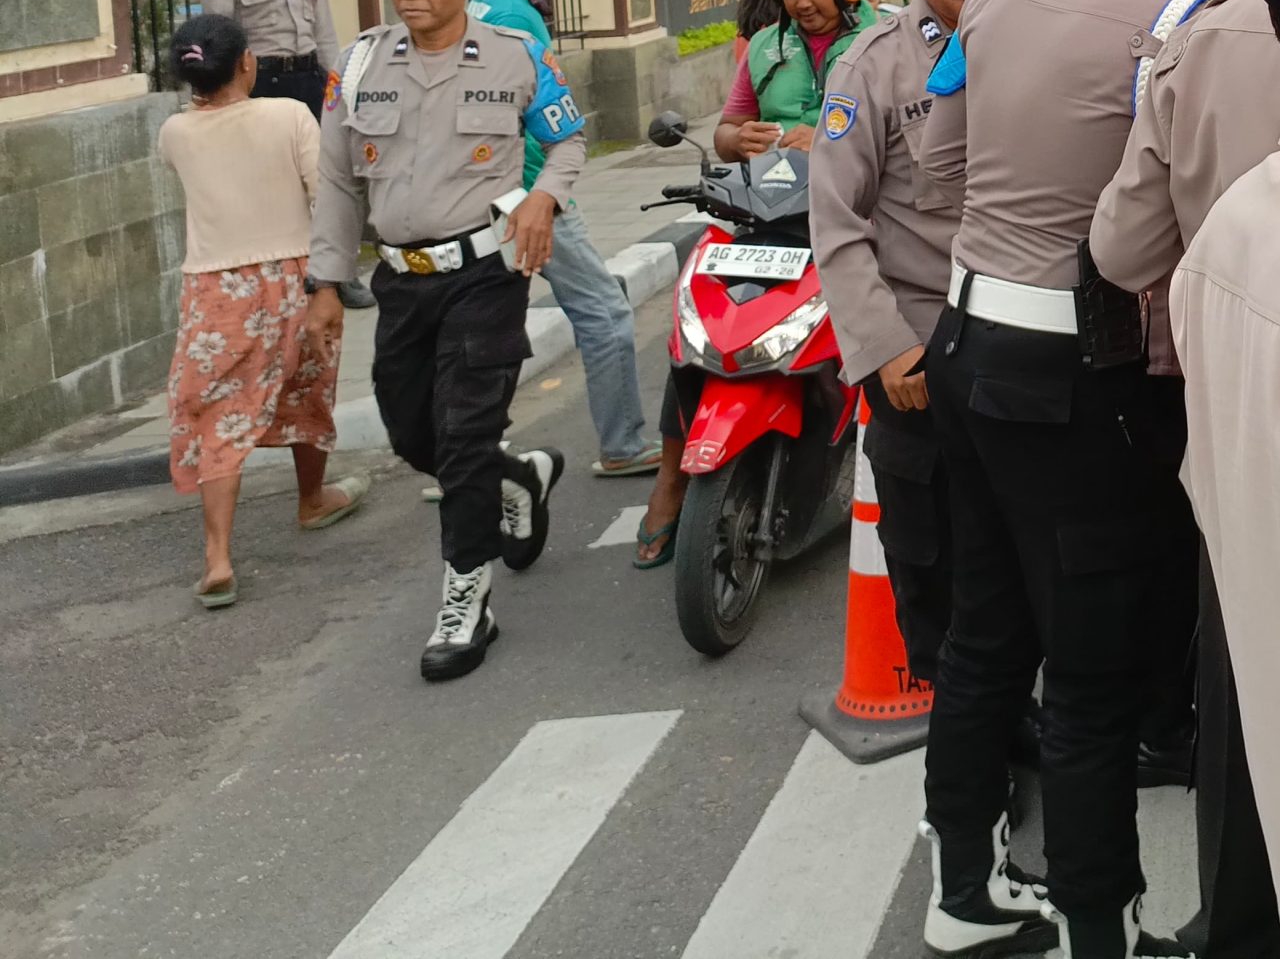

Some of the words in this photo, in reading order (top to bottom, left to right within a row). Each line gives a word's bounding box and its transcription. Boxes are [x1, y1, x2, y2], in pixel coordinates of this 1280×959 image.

[464, 90, 516, 104] POLRI
[708, 246, 731, 260] AG
[734, 248, 776, 263] 2723
[780, 250, 804, 265] OH
